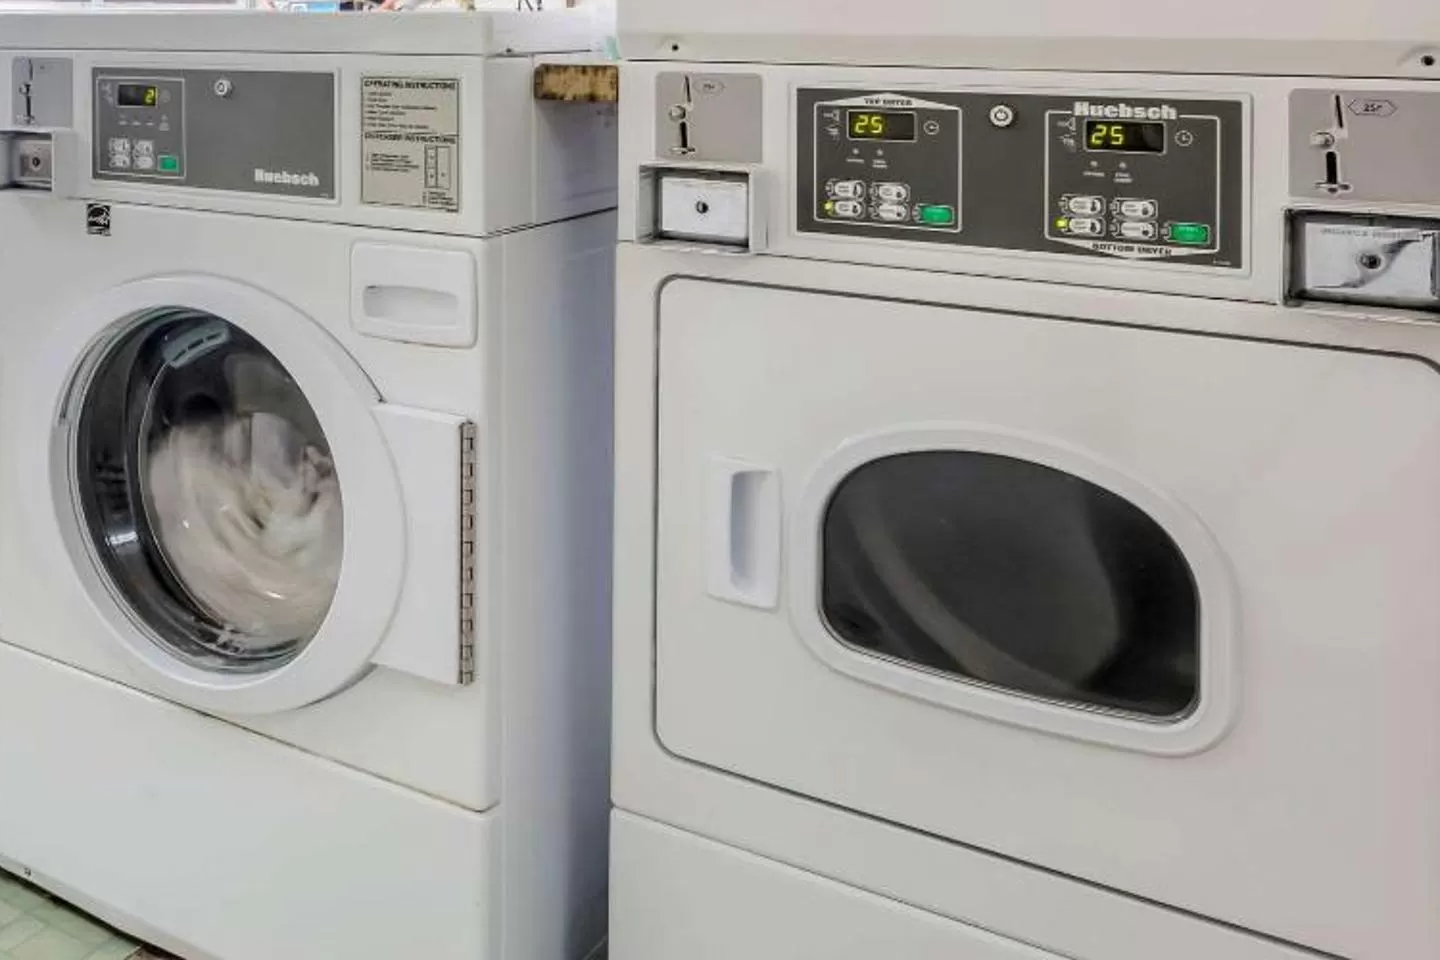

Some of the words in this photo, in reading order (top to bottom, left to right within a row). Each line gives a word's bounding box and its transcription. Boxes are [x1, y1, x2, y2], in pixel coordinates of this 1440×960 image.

[1073, 101, 1178, 120] Huebsch
[854, 115, 883, 134] 25
[1091, 124, 1125, 145] 25
[254, 168, 320, 187] Huebsch
